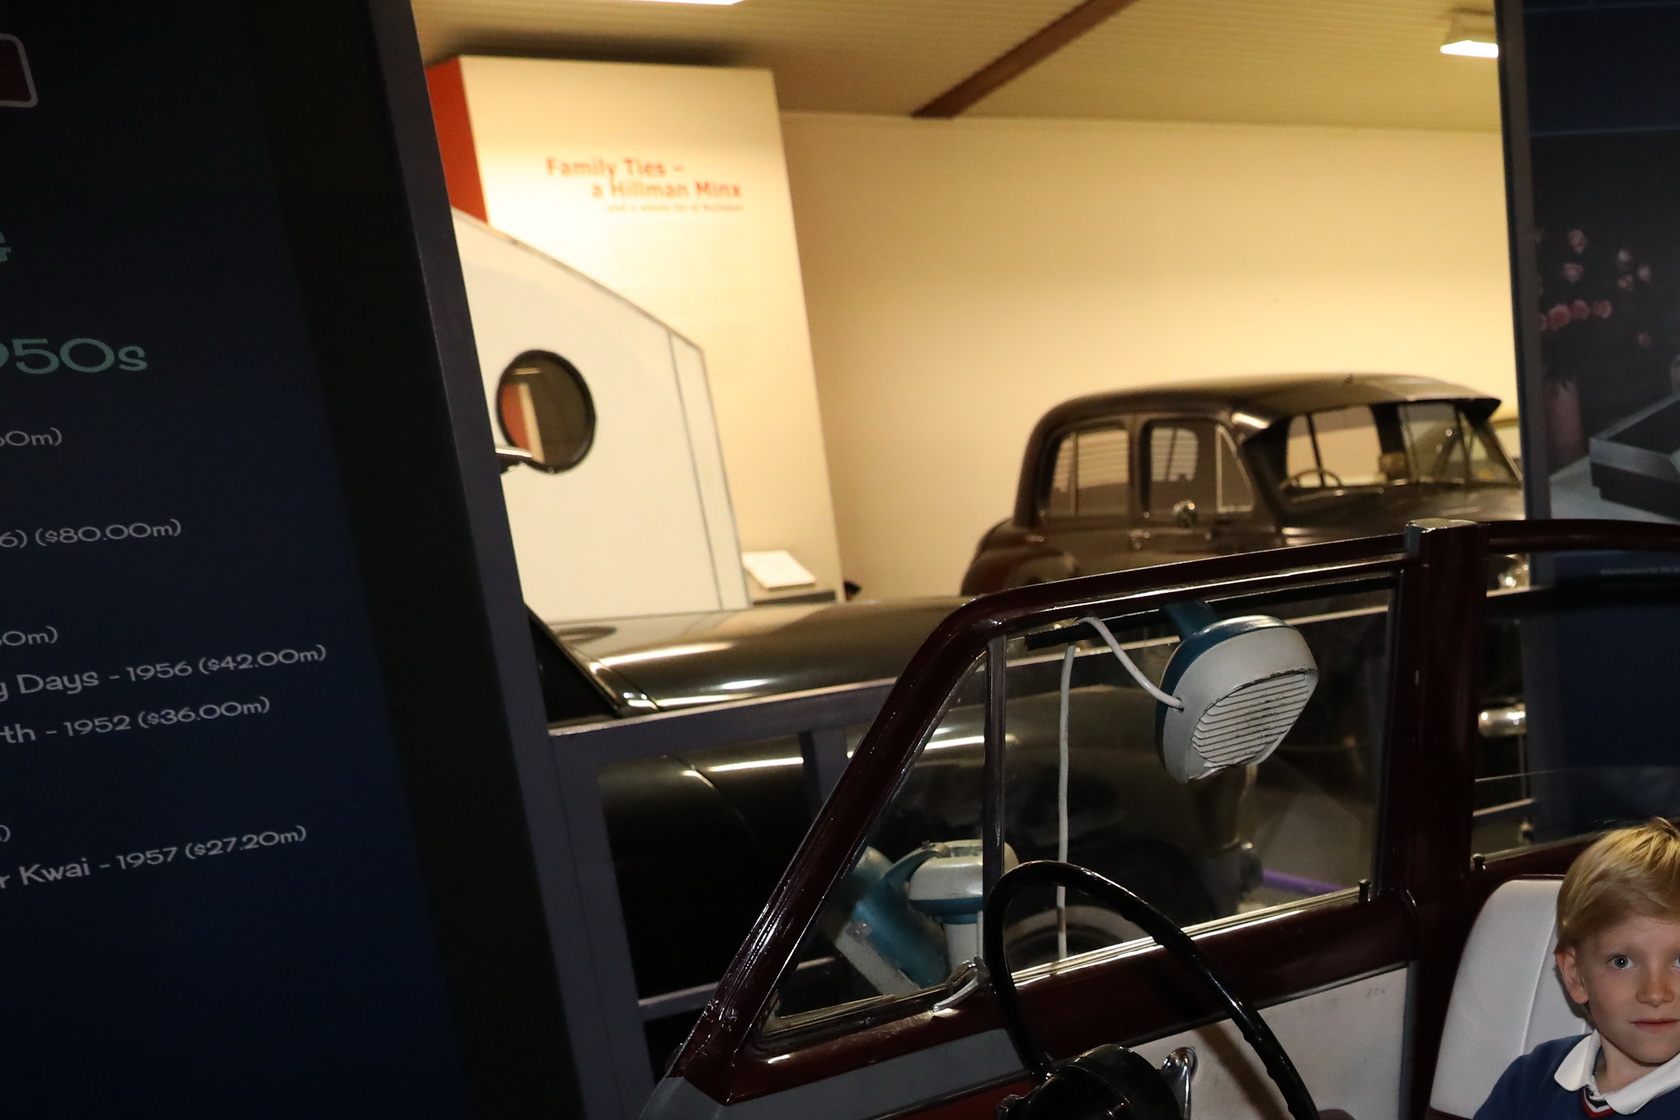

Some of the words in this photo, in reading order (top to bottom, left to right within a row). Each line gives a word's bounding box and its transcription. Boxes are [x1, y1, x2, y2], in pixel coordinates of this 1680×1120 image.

[546, 157, 616, 183] Family
[623, 157, 666, 178] Ties
[592, 184, 604, 199] a
[611, 180, 689, 199] Hillman
[695, 180, 742, 199] Minx
[0, 337, 148, 375] 50s
[35, 518, 183, 548] ($80.00m)
[16, 671, 99, 695] Days
[126, 661, 193, 683] 1956
[199, 644, 327, 676] ($42.00m)
[64, 715, 132, 738] 1952
[138, 696, 270, 729] ($36.00m)
[18, 857, 91, 886] Kwai
[116, 846, 178, 870] 1957
[185, 825, 308, 860] ($27.20m)
